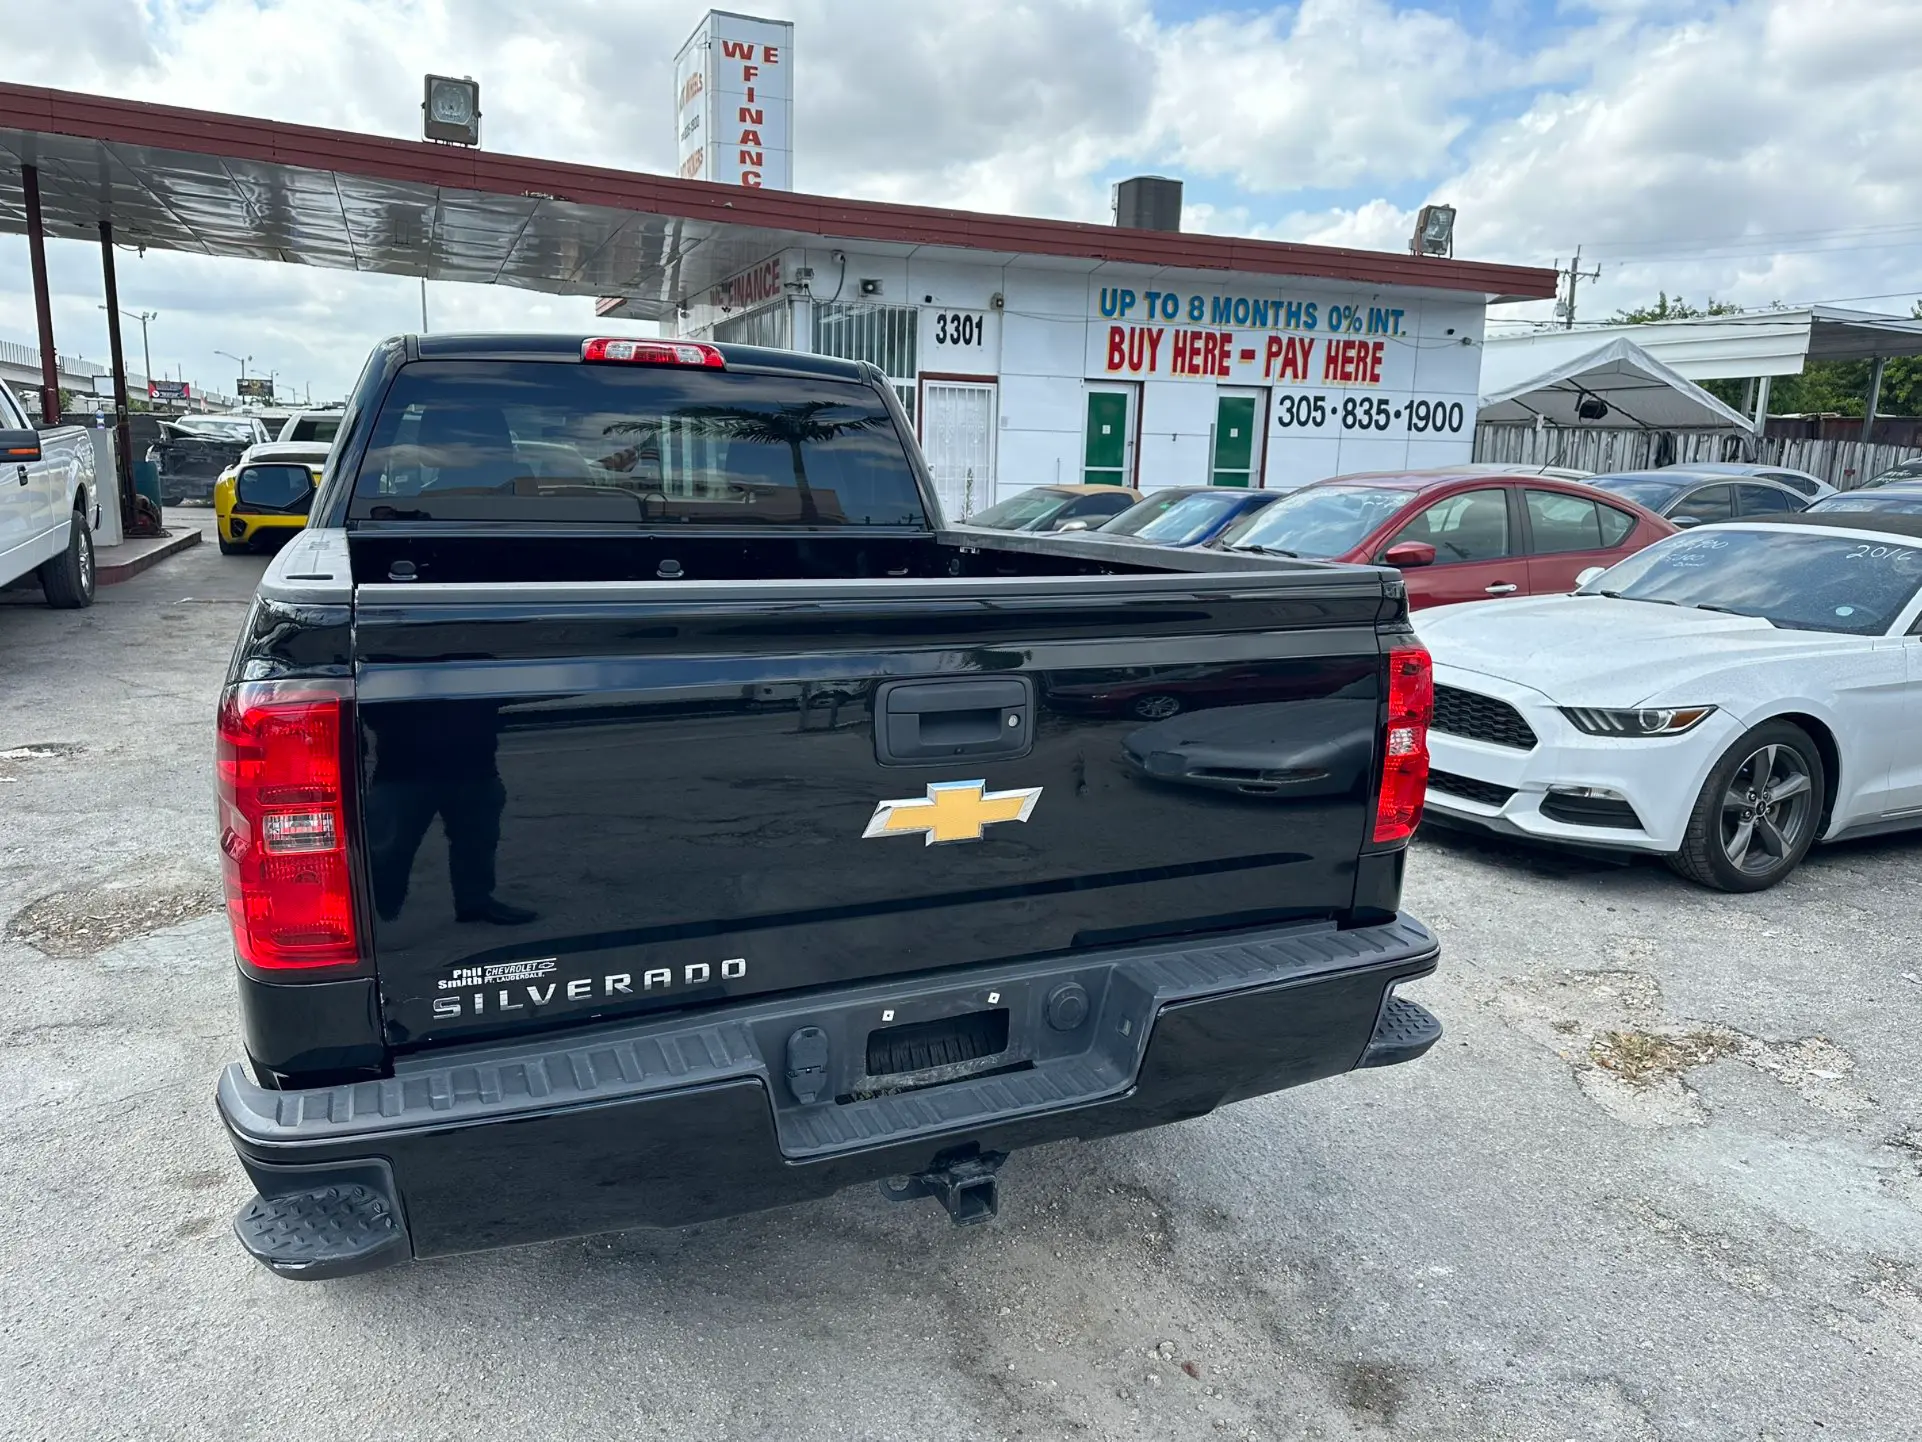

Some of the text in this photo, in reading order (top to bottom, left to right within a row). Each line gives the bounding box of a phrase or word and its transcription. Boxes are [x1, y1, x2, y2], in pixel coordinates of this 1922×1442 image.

[722, 40, 779, 64] WE
[728, 257, 780, 308] FINANCE
[1100, 288, 1407, 336] UP TO 8 MONTHS 0% INT.
[936, 313, 984, 347] 3301
[1105, 325, 1164, 374] BUY
[1170, 329, 1233, 377] HERE
[1263, 335, 1315, 382] PAY
[1322, 339, 1385, 385] HERE
[1845, 544, 1916, 561] 2016
[452, 967, 482, 979] Phil
[484, 976, 495, 984] FT.
[485, 962, 538, 977] CHEVROLET
[432, 957, 747, 1020] SILVERADO
[437, 976, 482, 989] Smith
